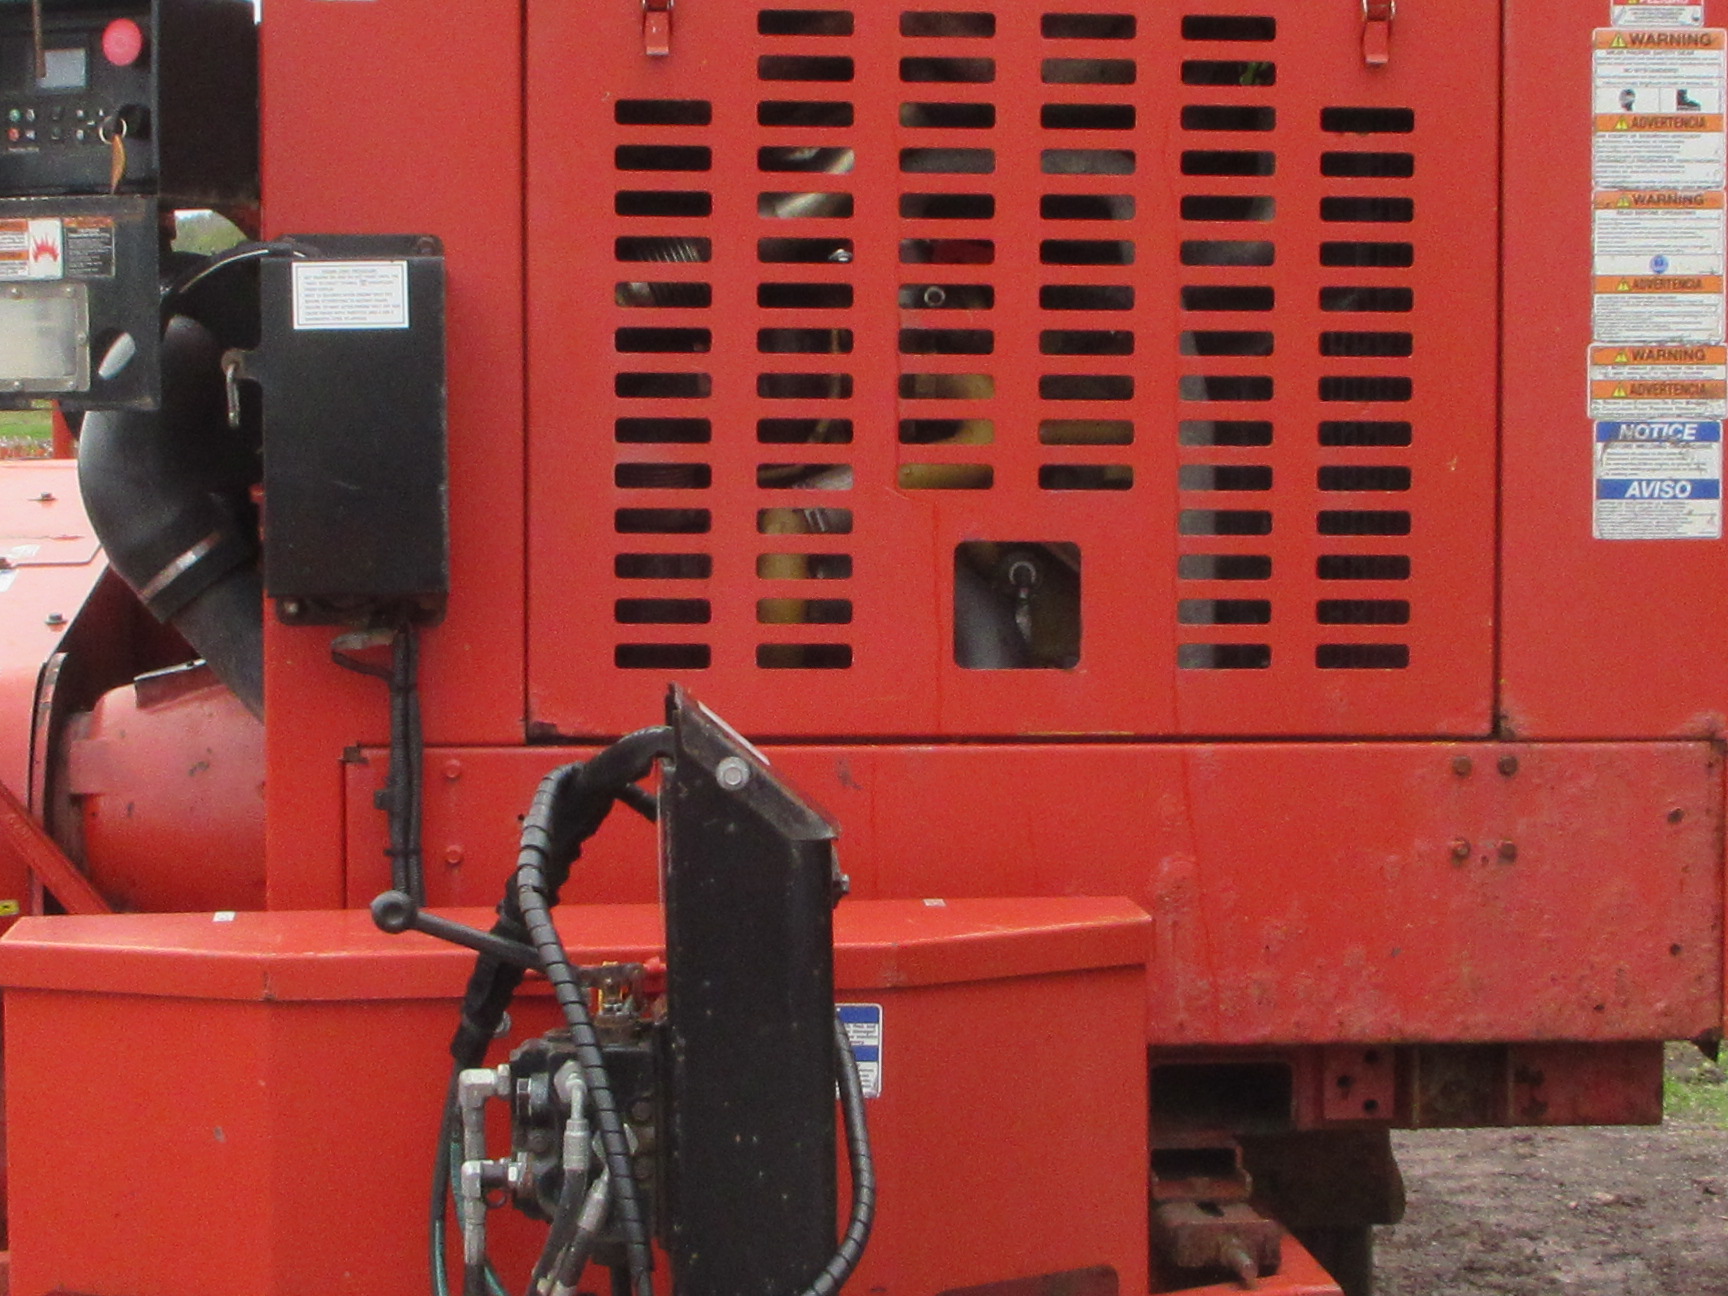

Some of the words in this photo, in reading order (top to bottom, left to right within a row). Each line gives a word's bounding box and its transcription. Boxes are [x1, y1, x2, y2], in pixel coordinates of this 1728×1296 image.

[1629, 33, 1712, 46] WARNING
[1632, 116, 1706, 128] ADVERTENCIA
[1632, 193, 1705, 205] WARNING
[1632, 278, 1703, 289] ADVERTENCIA
[1632, 349, 1706, 361] WARNING
[1630, 383, 1706, 396] ADVERTENCIA
[1619, 423, 1698, 440] NOTICE
[1624, 480, 1692, 498] AVISO
